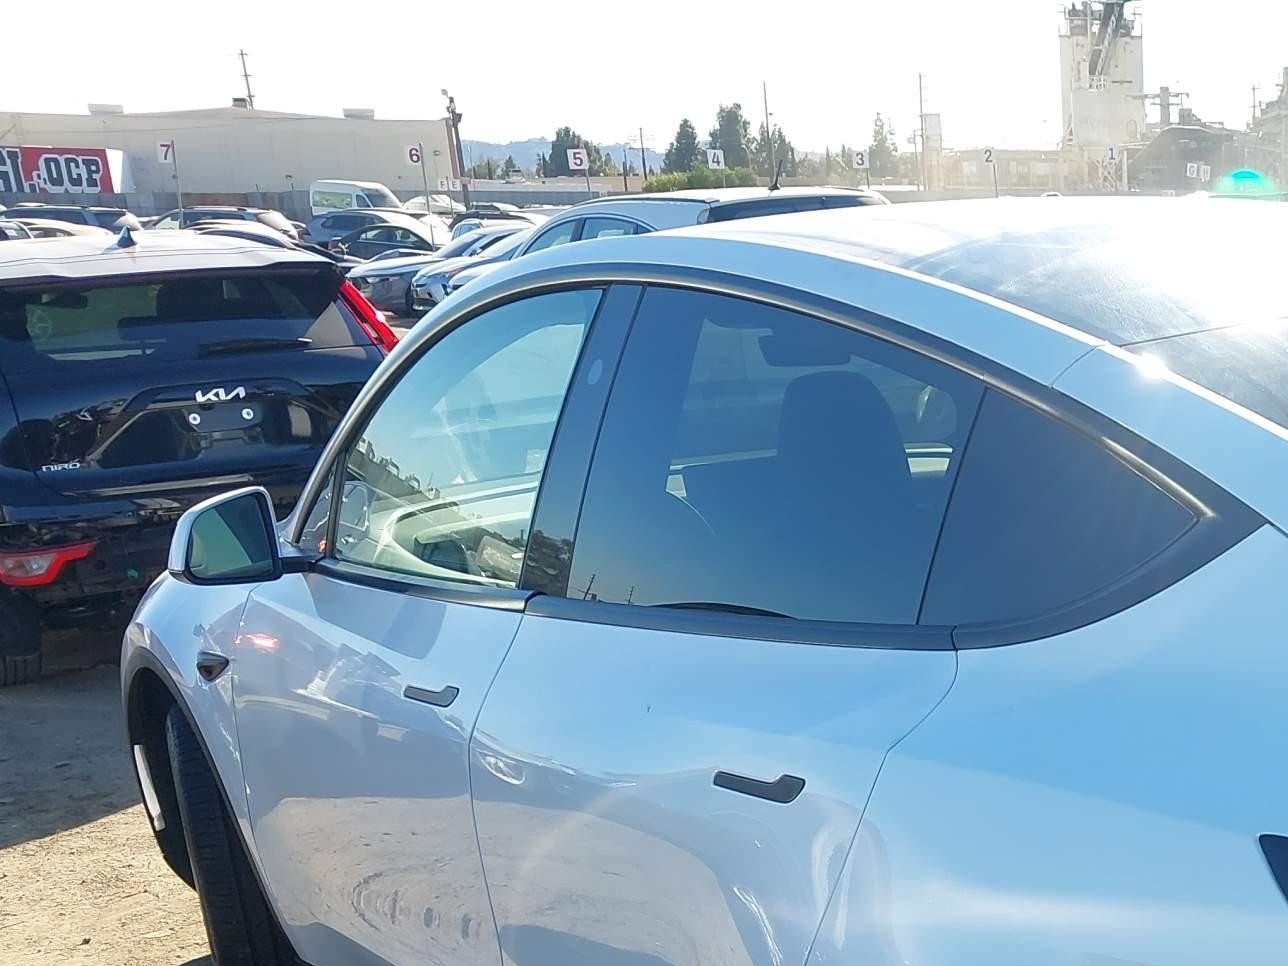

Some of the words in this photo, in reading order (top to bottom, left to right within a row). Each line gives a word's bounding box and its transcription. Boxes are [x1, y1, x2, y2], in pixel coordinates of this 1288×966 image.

[160, 143, 171, 161] 7
[408, 147, 420, 164] 6
[572, 150, 584, 167] 5
[855, 152, 865, 166] 3
[984, 149, 993, 163] 2
[1108, 147, 1116, 161] 1
[711, 152, 721, 167] 4
[451, 181, 458, 190] E
